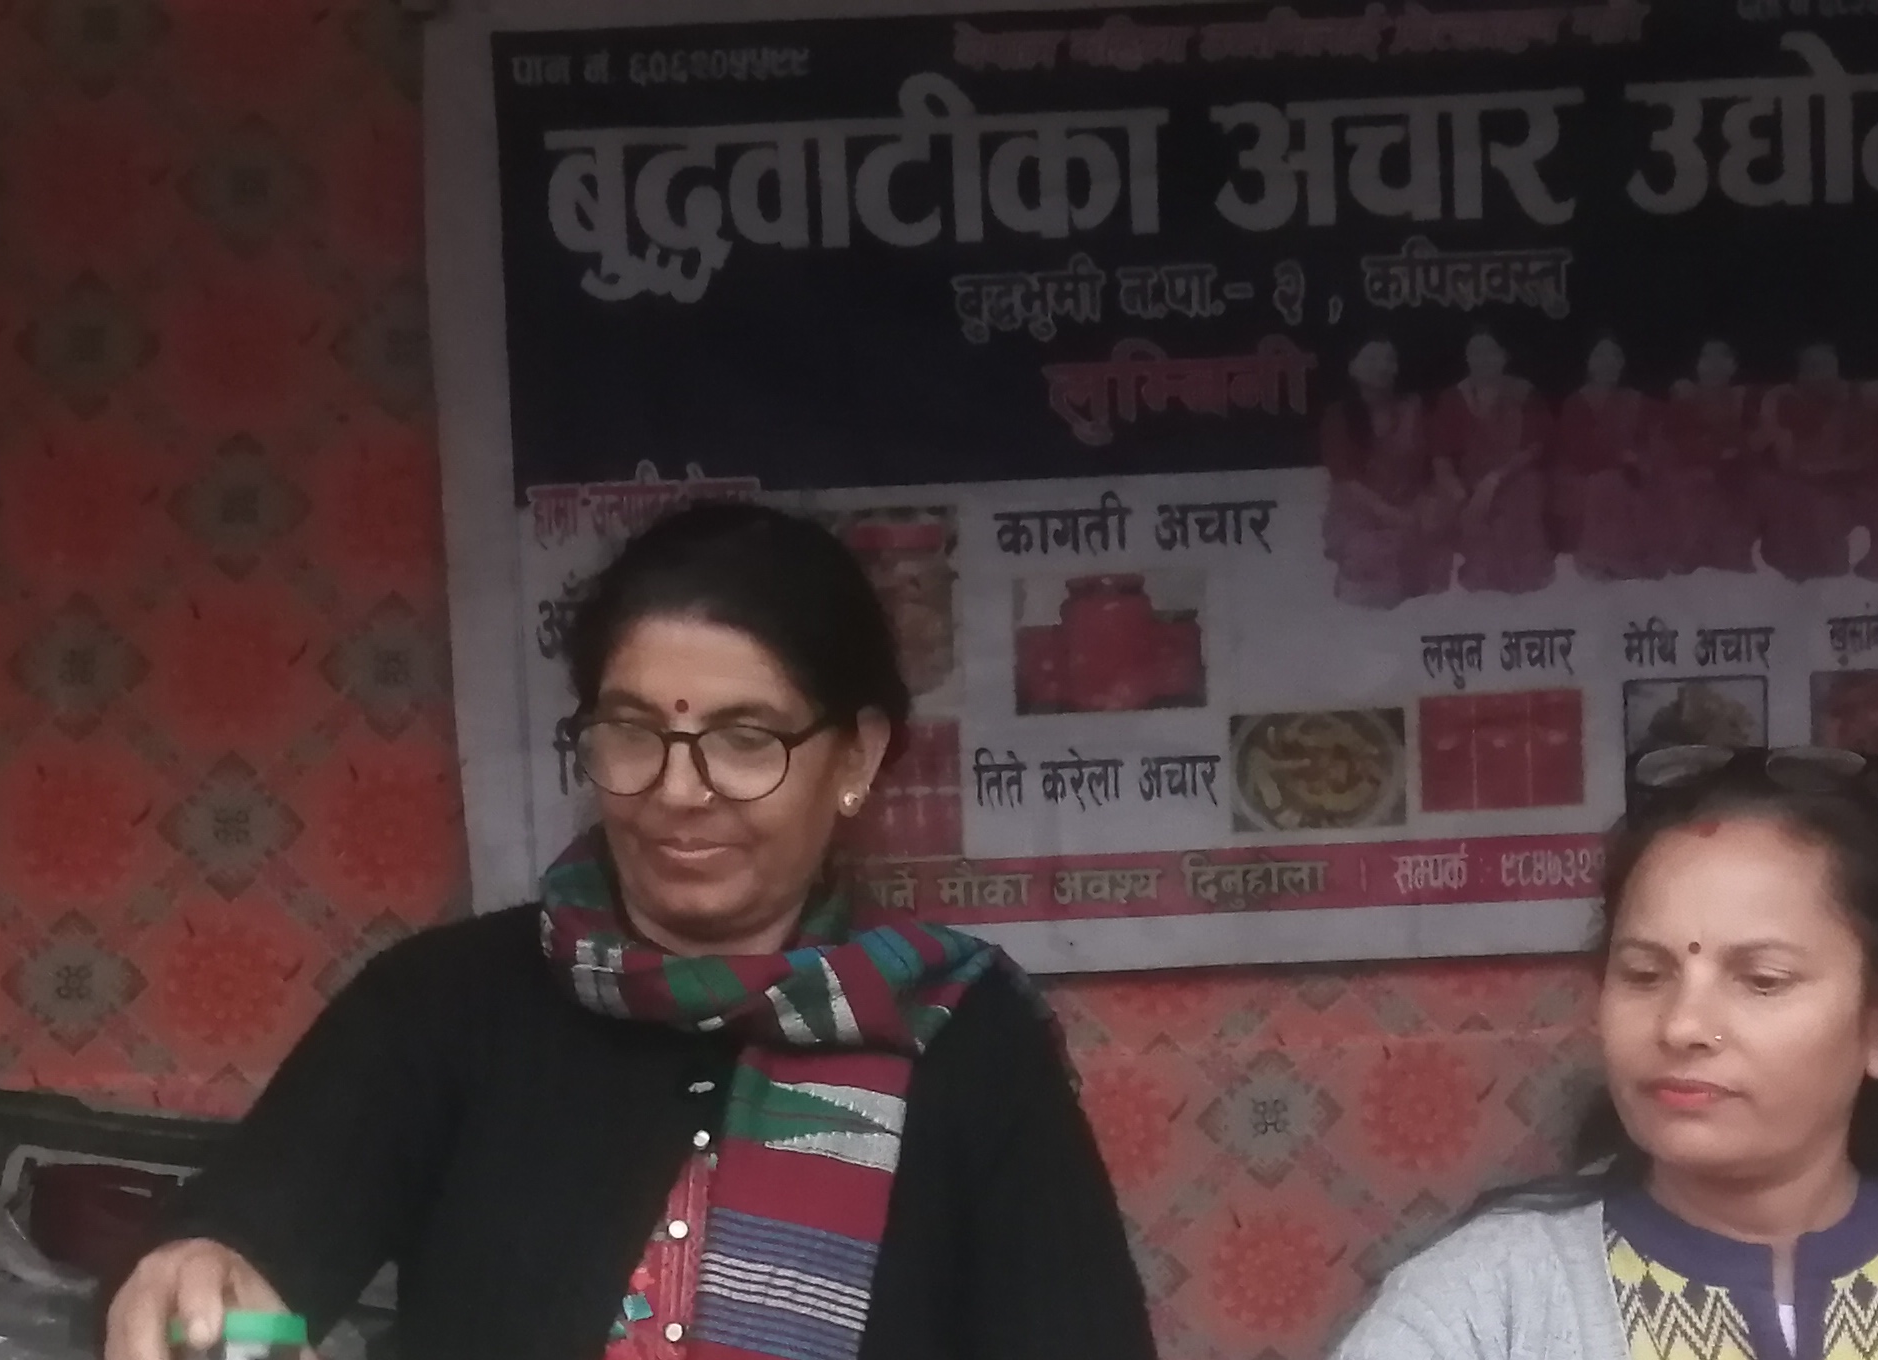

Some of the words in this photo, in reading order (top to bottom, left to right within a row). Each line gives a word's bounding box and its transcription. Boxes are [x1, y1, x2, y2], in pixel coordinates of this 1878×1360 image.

[1211, 86, 1585, 232] अचार
[1361, 235, 1572, 319] कपिलवस्तु
[992, 491, 1129, 556] कागती
[1154, 499, 1278, 553] अचार
[1421, 631, 1486, 689] लसुन
[1500, 627, 1575, 676] अचार
[1695, 626, 1775, 674] अचार
[973, 747, 1028, 809] तिते
[1041, 748, 1124, 812] करेला
[1139, 754, 1221, 808] अचार
[937, 859, 1033, 909] मौका
[1053, 868, 1162, 907] अवश्य
[1181, 850, 1329, 912] दिनुहोला
[1390, 846, 1469, 894] सम्पर्क
